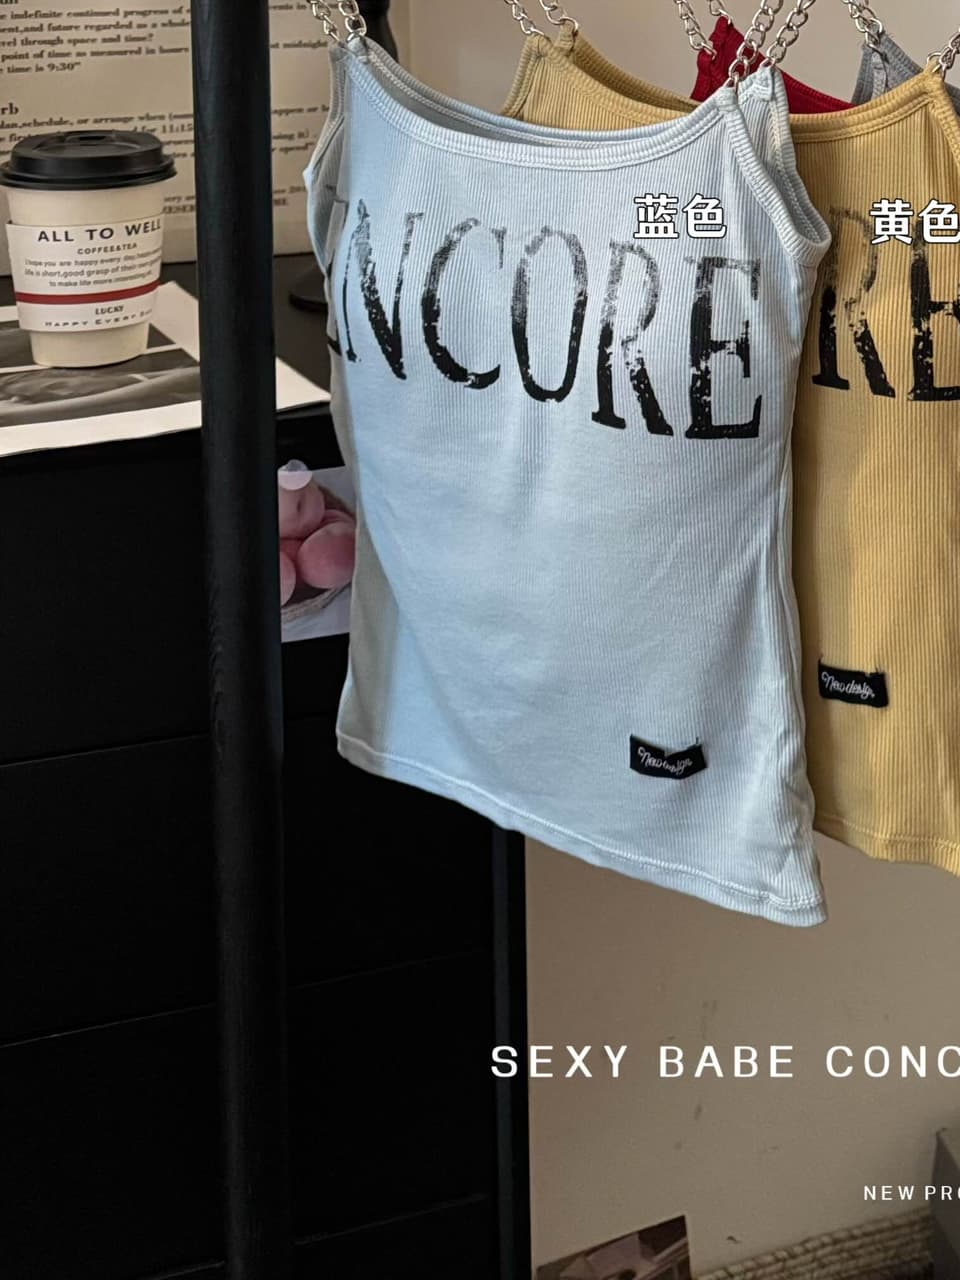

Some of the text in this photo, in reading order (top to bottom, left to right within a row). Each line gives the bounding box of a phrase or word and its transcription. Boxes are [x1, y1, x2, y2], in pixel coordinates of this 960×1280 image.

[48, 23, 81, 32] future
[84, 21, 132, 32] regarded
[21, 35, 64, 47] through
[67, 38, 98, 47] space
[101, 34, 121, 43] and
[38, 219, 161, 243] ALL TO WELL
[77, 242, 138, 255] COFFEE&TEA
[95, 305, 125, 315] LUCKY
[328, 198, 763, 440] NCORE
